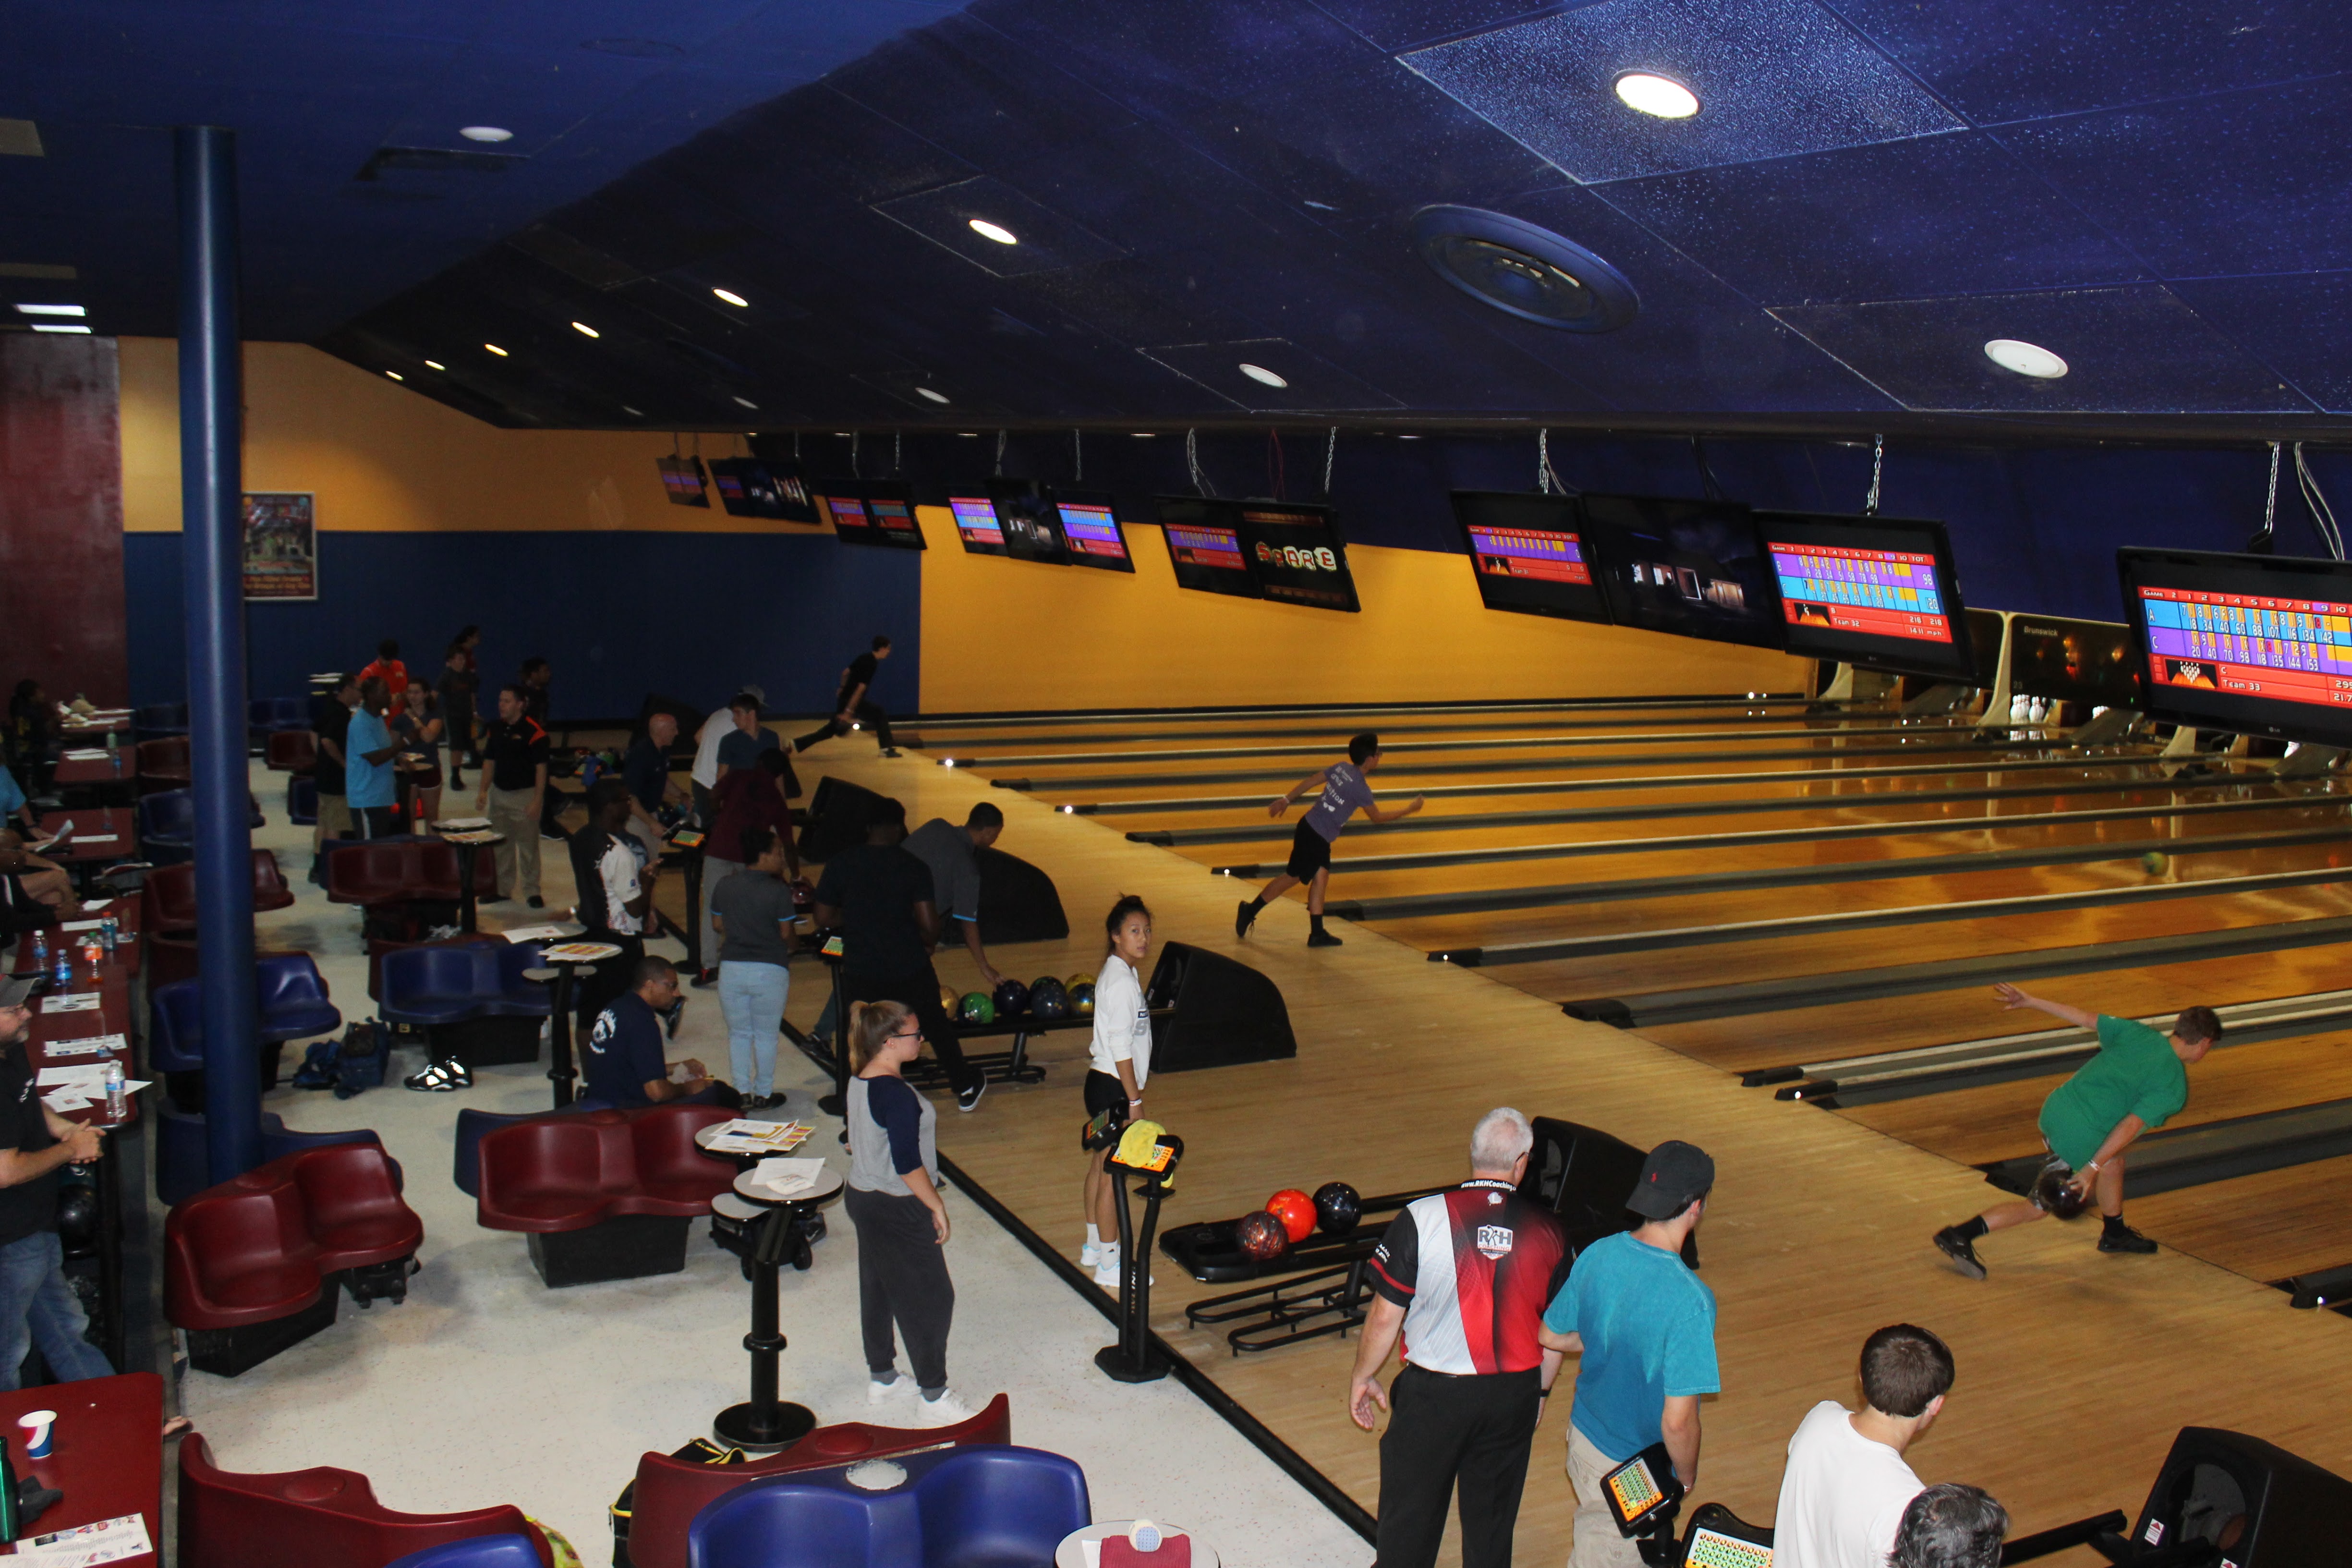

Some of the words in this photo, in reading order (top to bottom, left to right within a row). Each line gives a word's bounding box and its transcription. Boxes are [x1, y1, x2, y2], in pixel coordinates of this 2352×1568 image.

[1256, 542, 1336, 570] SPARE
[1923, 573, 1933, 585] 98
[2148, 608, 2155, 621] A
[2024, 625, 2059, 637] Brunswick
[2189, 619, 2197, 630] 18
[2203, 620, 2213, 632] 34
[2219, 621, 2229, 632] 40
[2235, 622, 2245, 635] 60
[2252, 624, 2263, 636] 88
[2267, 626, 2279, 638] 107
[2287, 628, 2297, 640] 116
[2302, 629, 2315, 642] 134
[2320, 631, 2333, 644] 142
[2152, 636, 2158, 648] C
[2192, 645, 2201, 657] 20
[2207, 648, 2217, 659] 40
[2224, 649, 2233, 661] 70
[2240, 651, 2250, 663] 98
[2257, 653, 2267, 665] 118
[2272, 655, 2284, 667] 135
[2288, 656, 2301, 668] 144
[2307, 658, 2319, 671] 153
[2223, 679, 2245, 689] Team
[2249, 682, 2261, 691] 33
